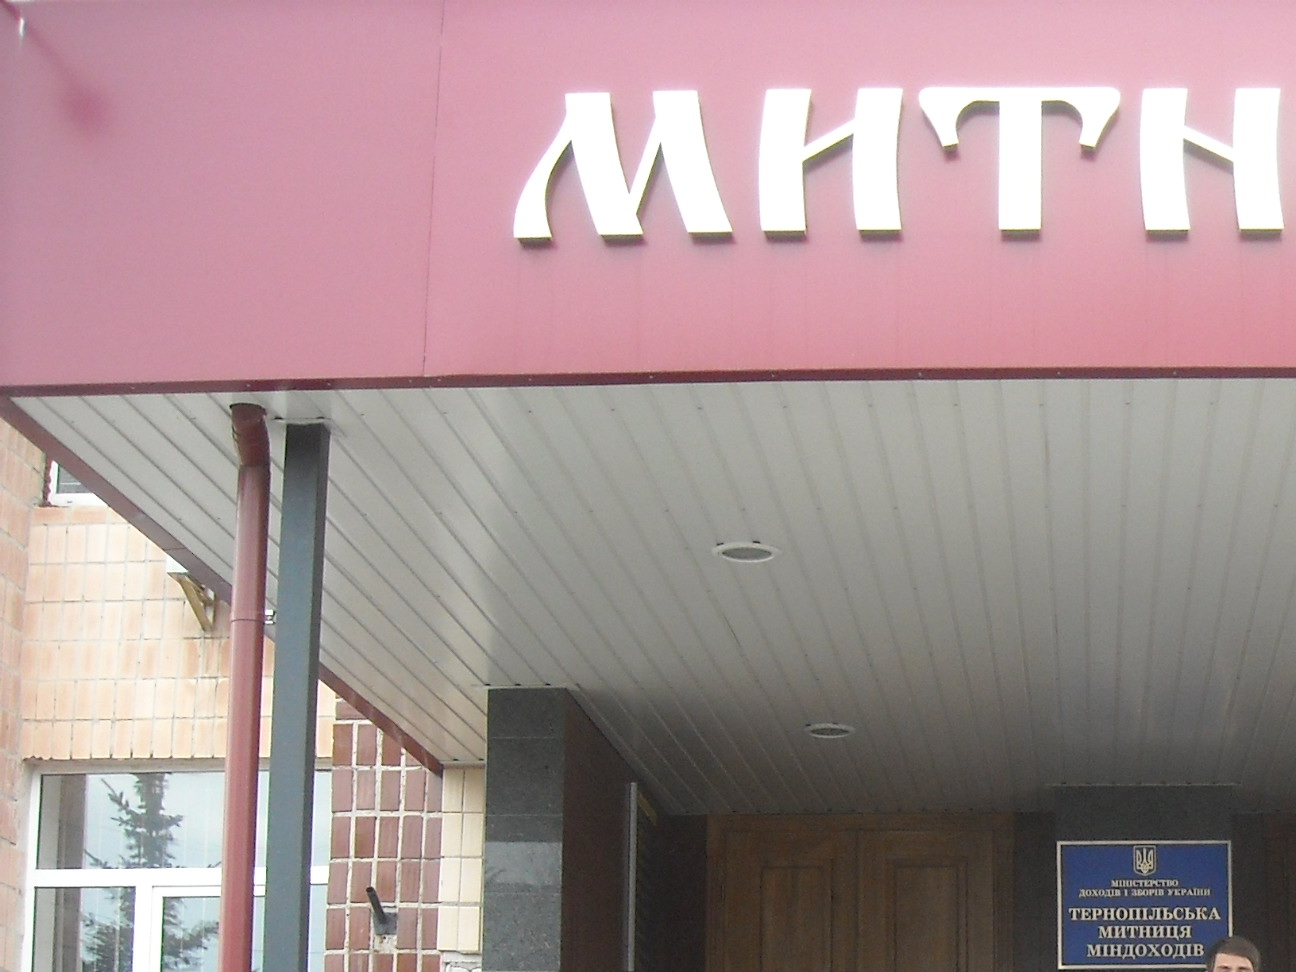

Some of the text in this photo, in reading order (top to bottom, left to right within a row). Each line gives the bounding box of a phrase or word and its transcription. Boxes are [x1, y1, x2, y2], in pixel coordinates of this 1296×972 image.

[1111, 879, 1179, 888] МІНІСТЕРСТВО
[1078, 888, 1121, 898] ДОХОДІВ
[1131, 888, 1165, 897] ЗБОРІВ
[1167, 887, 1211, 896] УКРАЇНИ
[1068, 906, 1221, 921] ТЕРНОПІЛЬСЬКА
[1098, 925, 1192, 941] МИТНИЦЯ
[1086, 943, 1205, 960] МІНДОХОДІВ
